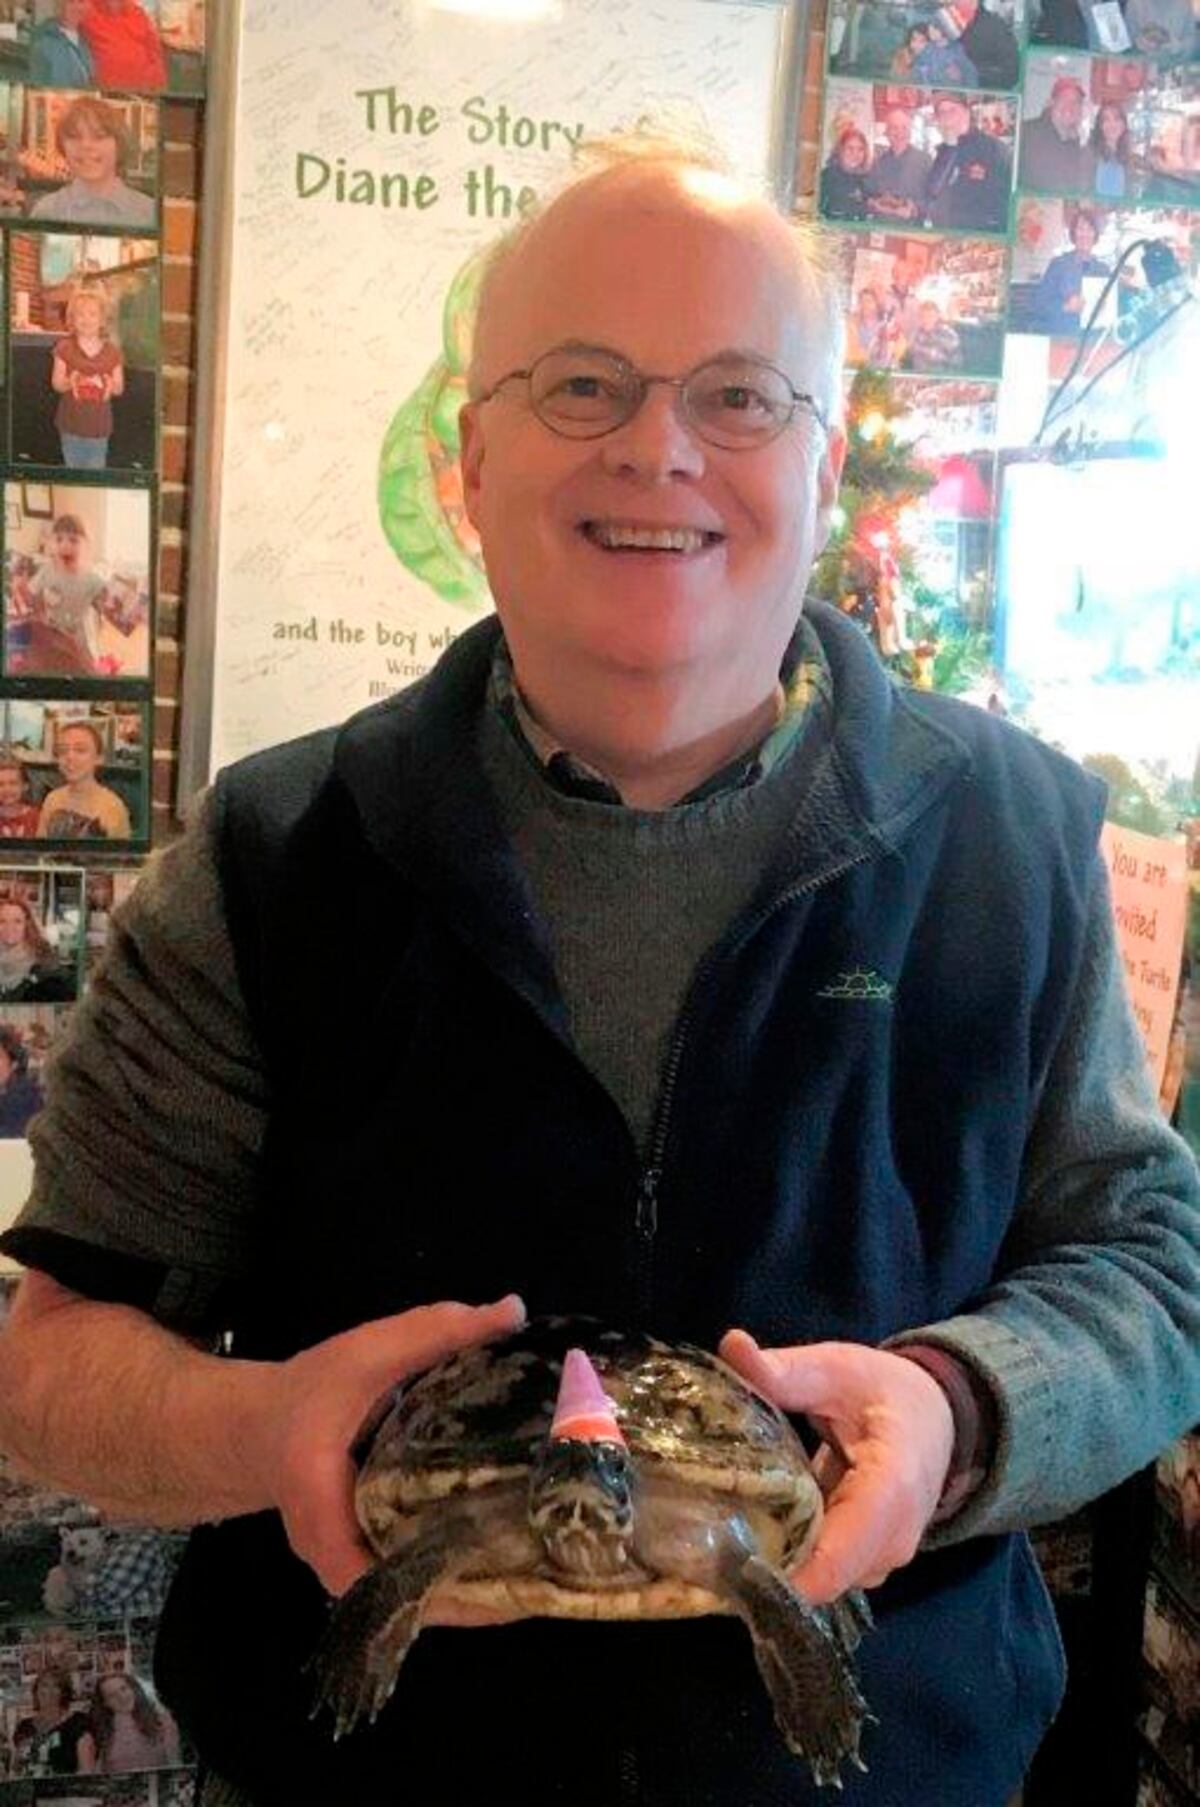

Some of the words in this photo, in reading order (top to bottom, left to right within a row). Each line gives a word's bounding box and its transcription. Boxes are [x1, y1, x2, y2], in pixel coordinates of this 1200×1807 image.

[355, 86, 439, 136] The
[461, 96, 584, 151] Story
[296, 153, 438, 209] Diane
[464, 165, 537, 217] the
[272, 617, 318, 641] and
[330, 619, 365, 643] the
[377, 622, 418, 655] boy
[428, 627, 459, 650] wh
[1111, 842, 1138, 878] You
